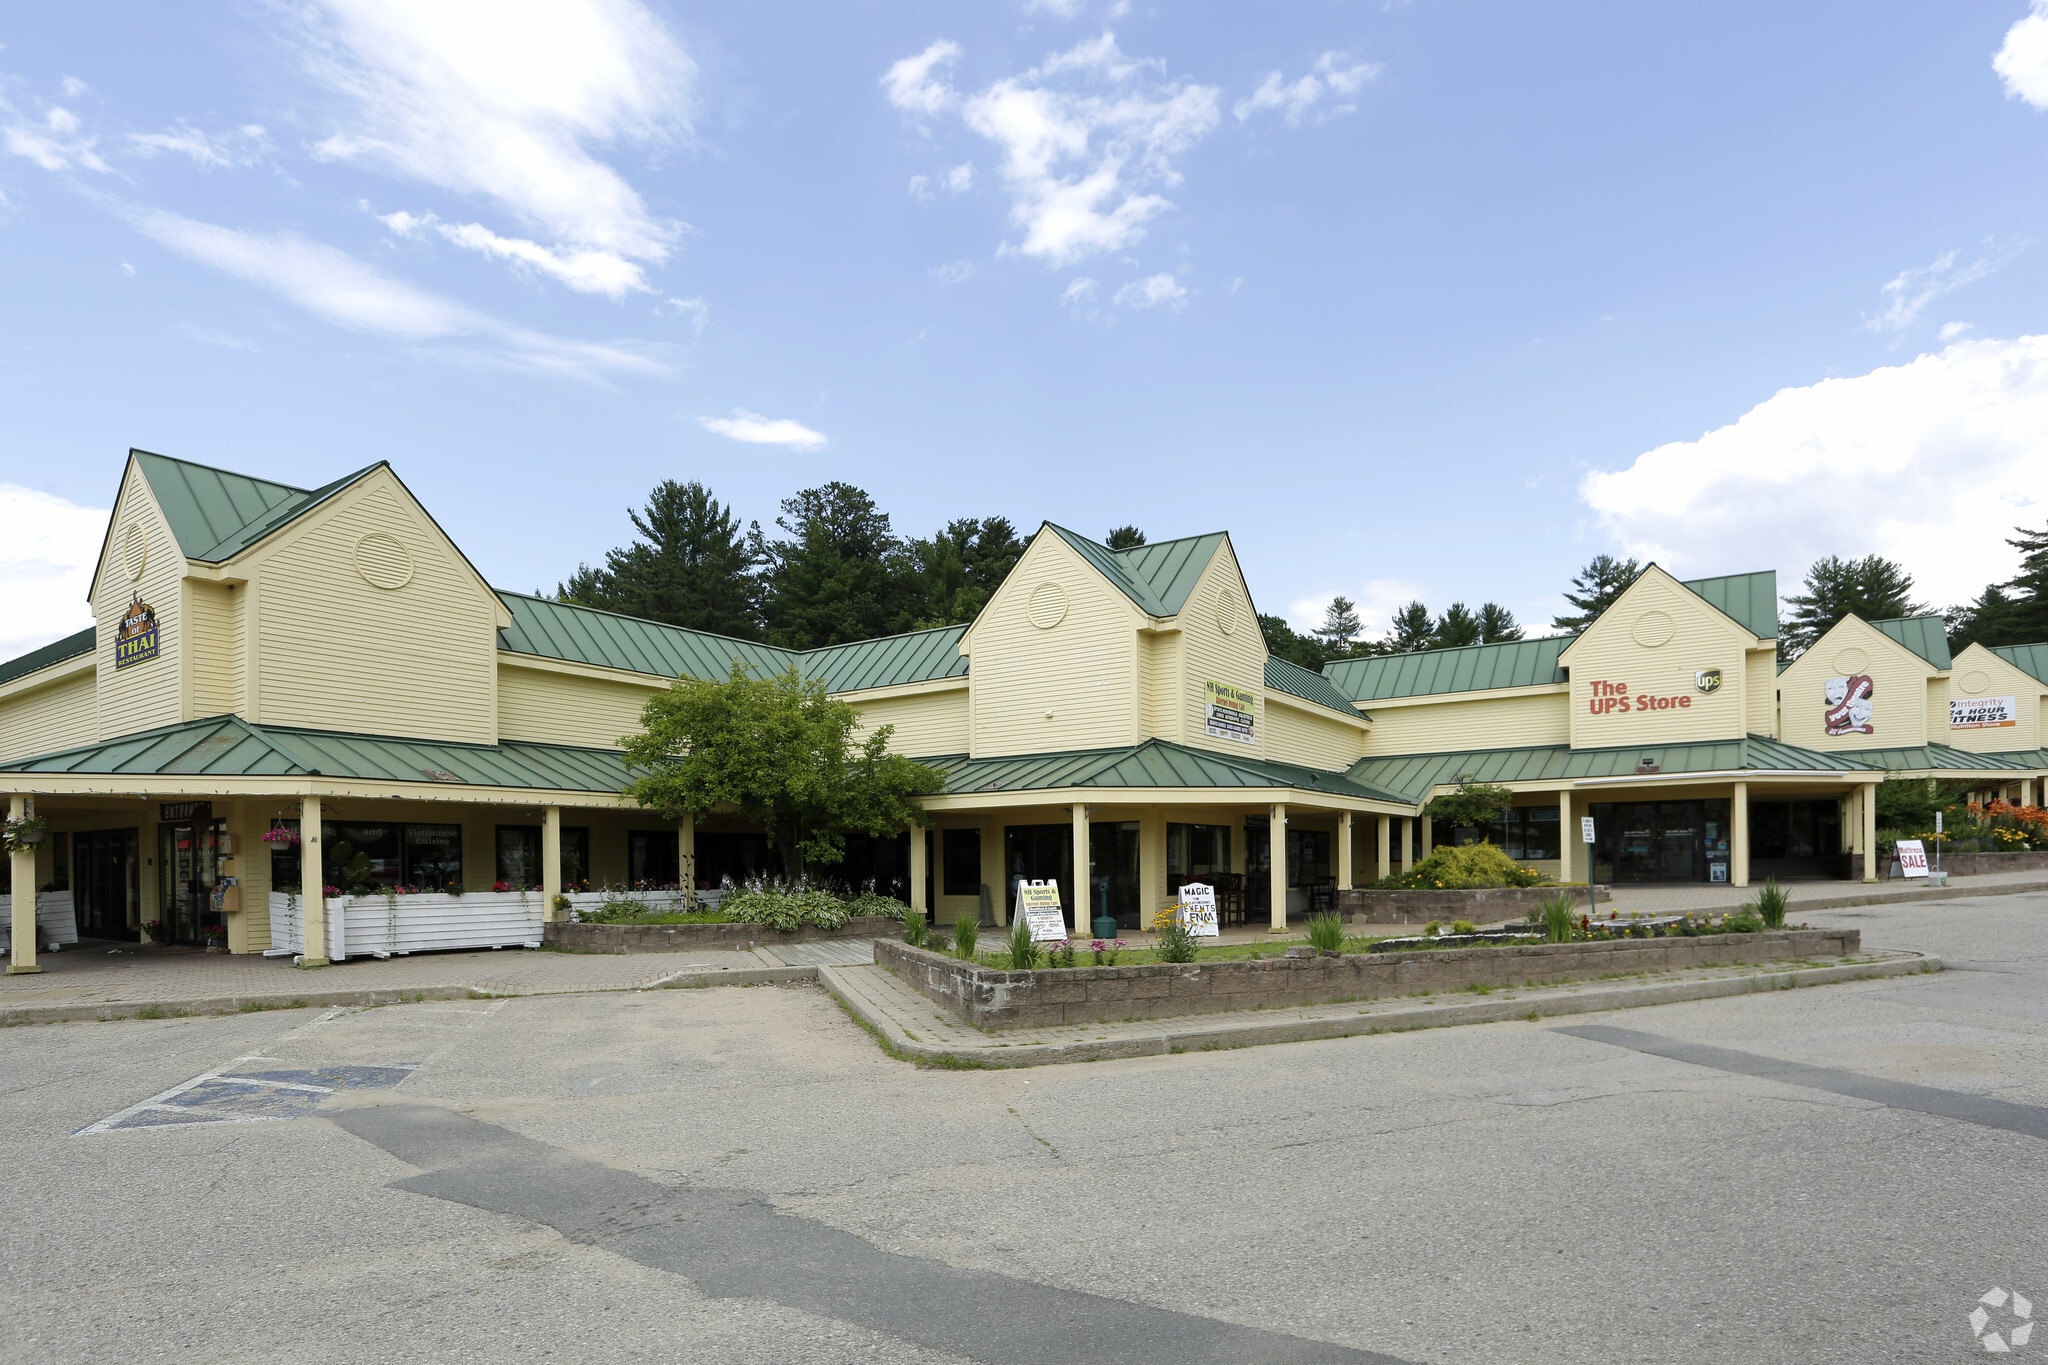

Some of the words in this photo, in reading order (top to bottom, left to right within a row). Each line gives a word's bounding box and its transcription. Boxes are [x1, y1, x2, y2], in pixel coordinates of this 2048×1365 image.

[125, 612, 148, 628] TASTE
[131, 626, 141, 635] OF
[118, 633, 155, 658] THAI
[118, 649, 156, 666] RESTAURANT
[1697, 675, 1721, 690] ups
[1215, 684, 1230, 697] Sports
[1590, 680, 1628, 697] The
[1590, 696, 1631, 715] UPS
[1636, 695, 1692, 712] Store
[1957, 699, 2004, 708] Integrity
[1968, 707, 2005, 715] HOUR
[362, 828, 383, 836] and
[408, 828, 458, 837] Vietnamese
[415, 837, 451, 845] Cuisine
[1901, 855, 1927, 869] SALE
[1184, 887, 1210, 896] MAGIC
[1184, 904, 1216, 913] EVENTS
[1189, 912, 1214, 922] FNM
